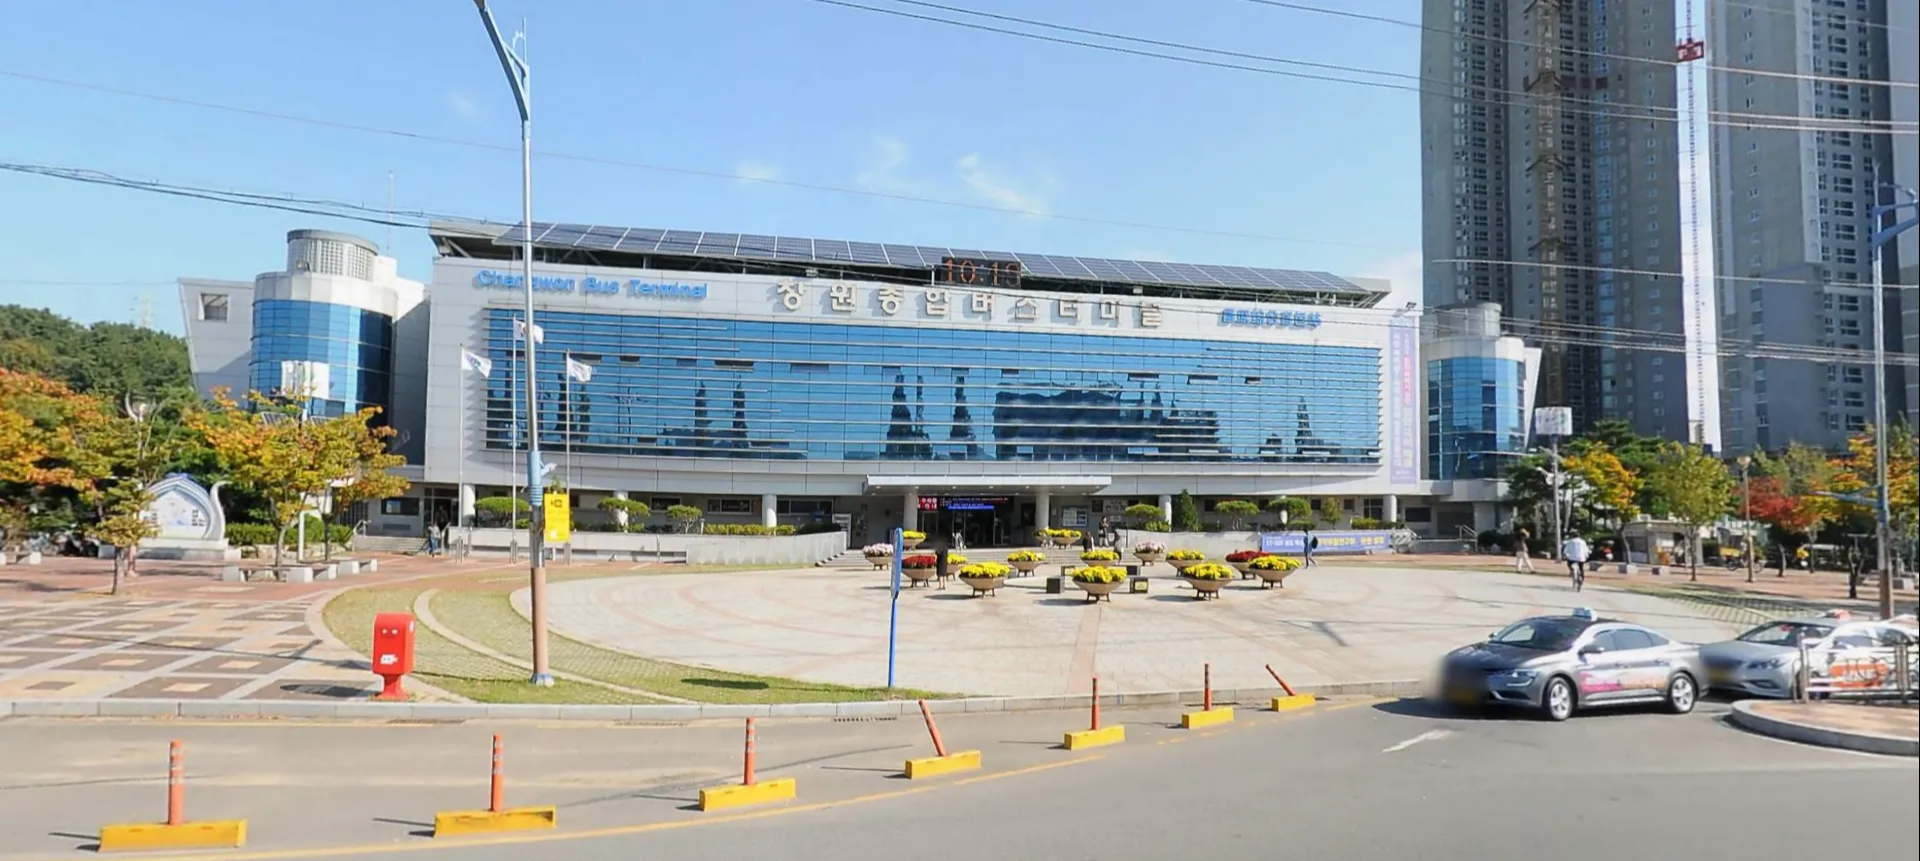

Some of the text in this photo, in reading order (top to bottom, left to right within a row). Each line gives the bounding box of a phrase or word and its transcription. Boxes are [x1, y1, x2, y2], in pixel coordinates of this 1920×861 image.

[475, 269, 708, 299] Changwon Bus Terminal
[776, 277, 1162, 328] 창원종합버스터미널
